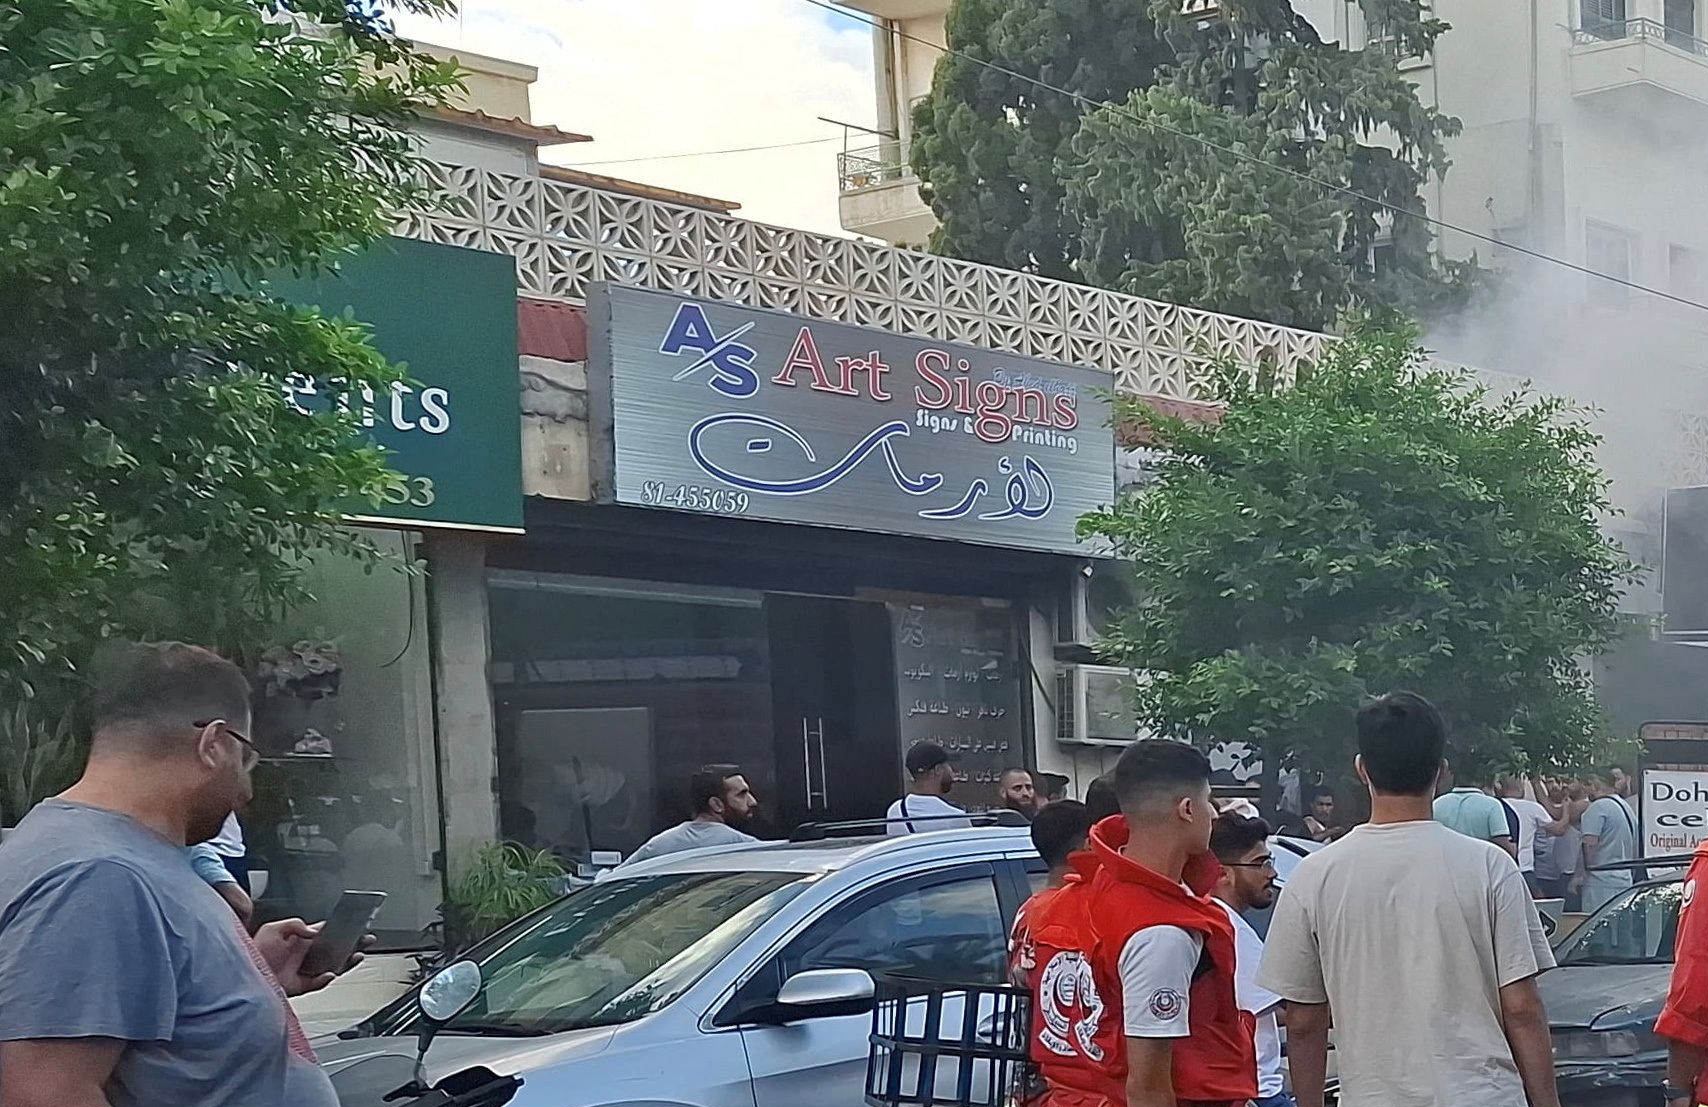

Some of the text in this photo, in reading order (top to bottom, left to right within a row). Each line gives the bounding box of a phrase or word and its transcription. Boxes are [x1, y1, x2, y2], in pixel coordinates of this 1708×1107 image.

[281, 370, 450, 434] ents
[771, 326, 892, 401] Art
[914, 349, 1078, 443] Signs
[915, 408, 1078, 455] Signs & Printing
[640, 480, 750, 515] 81-455059
[1650, 832, 1687, 852] Original
